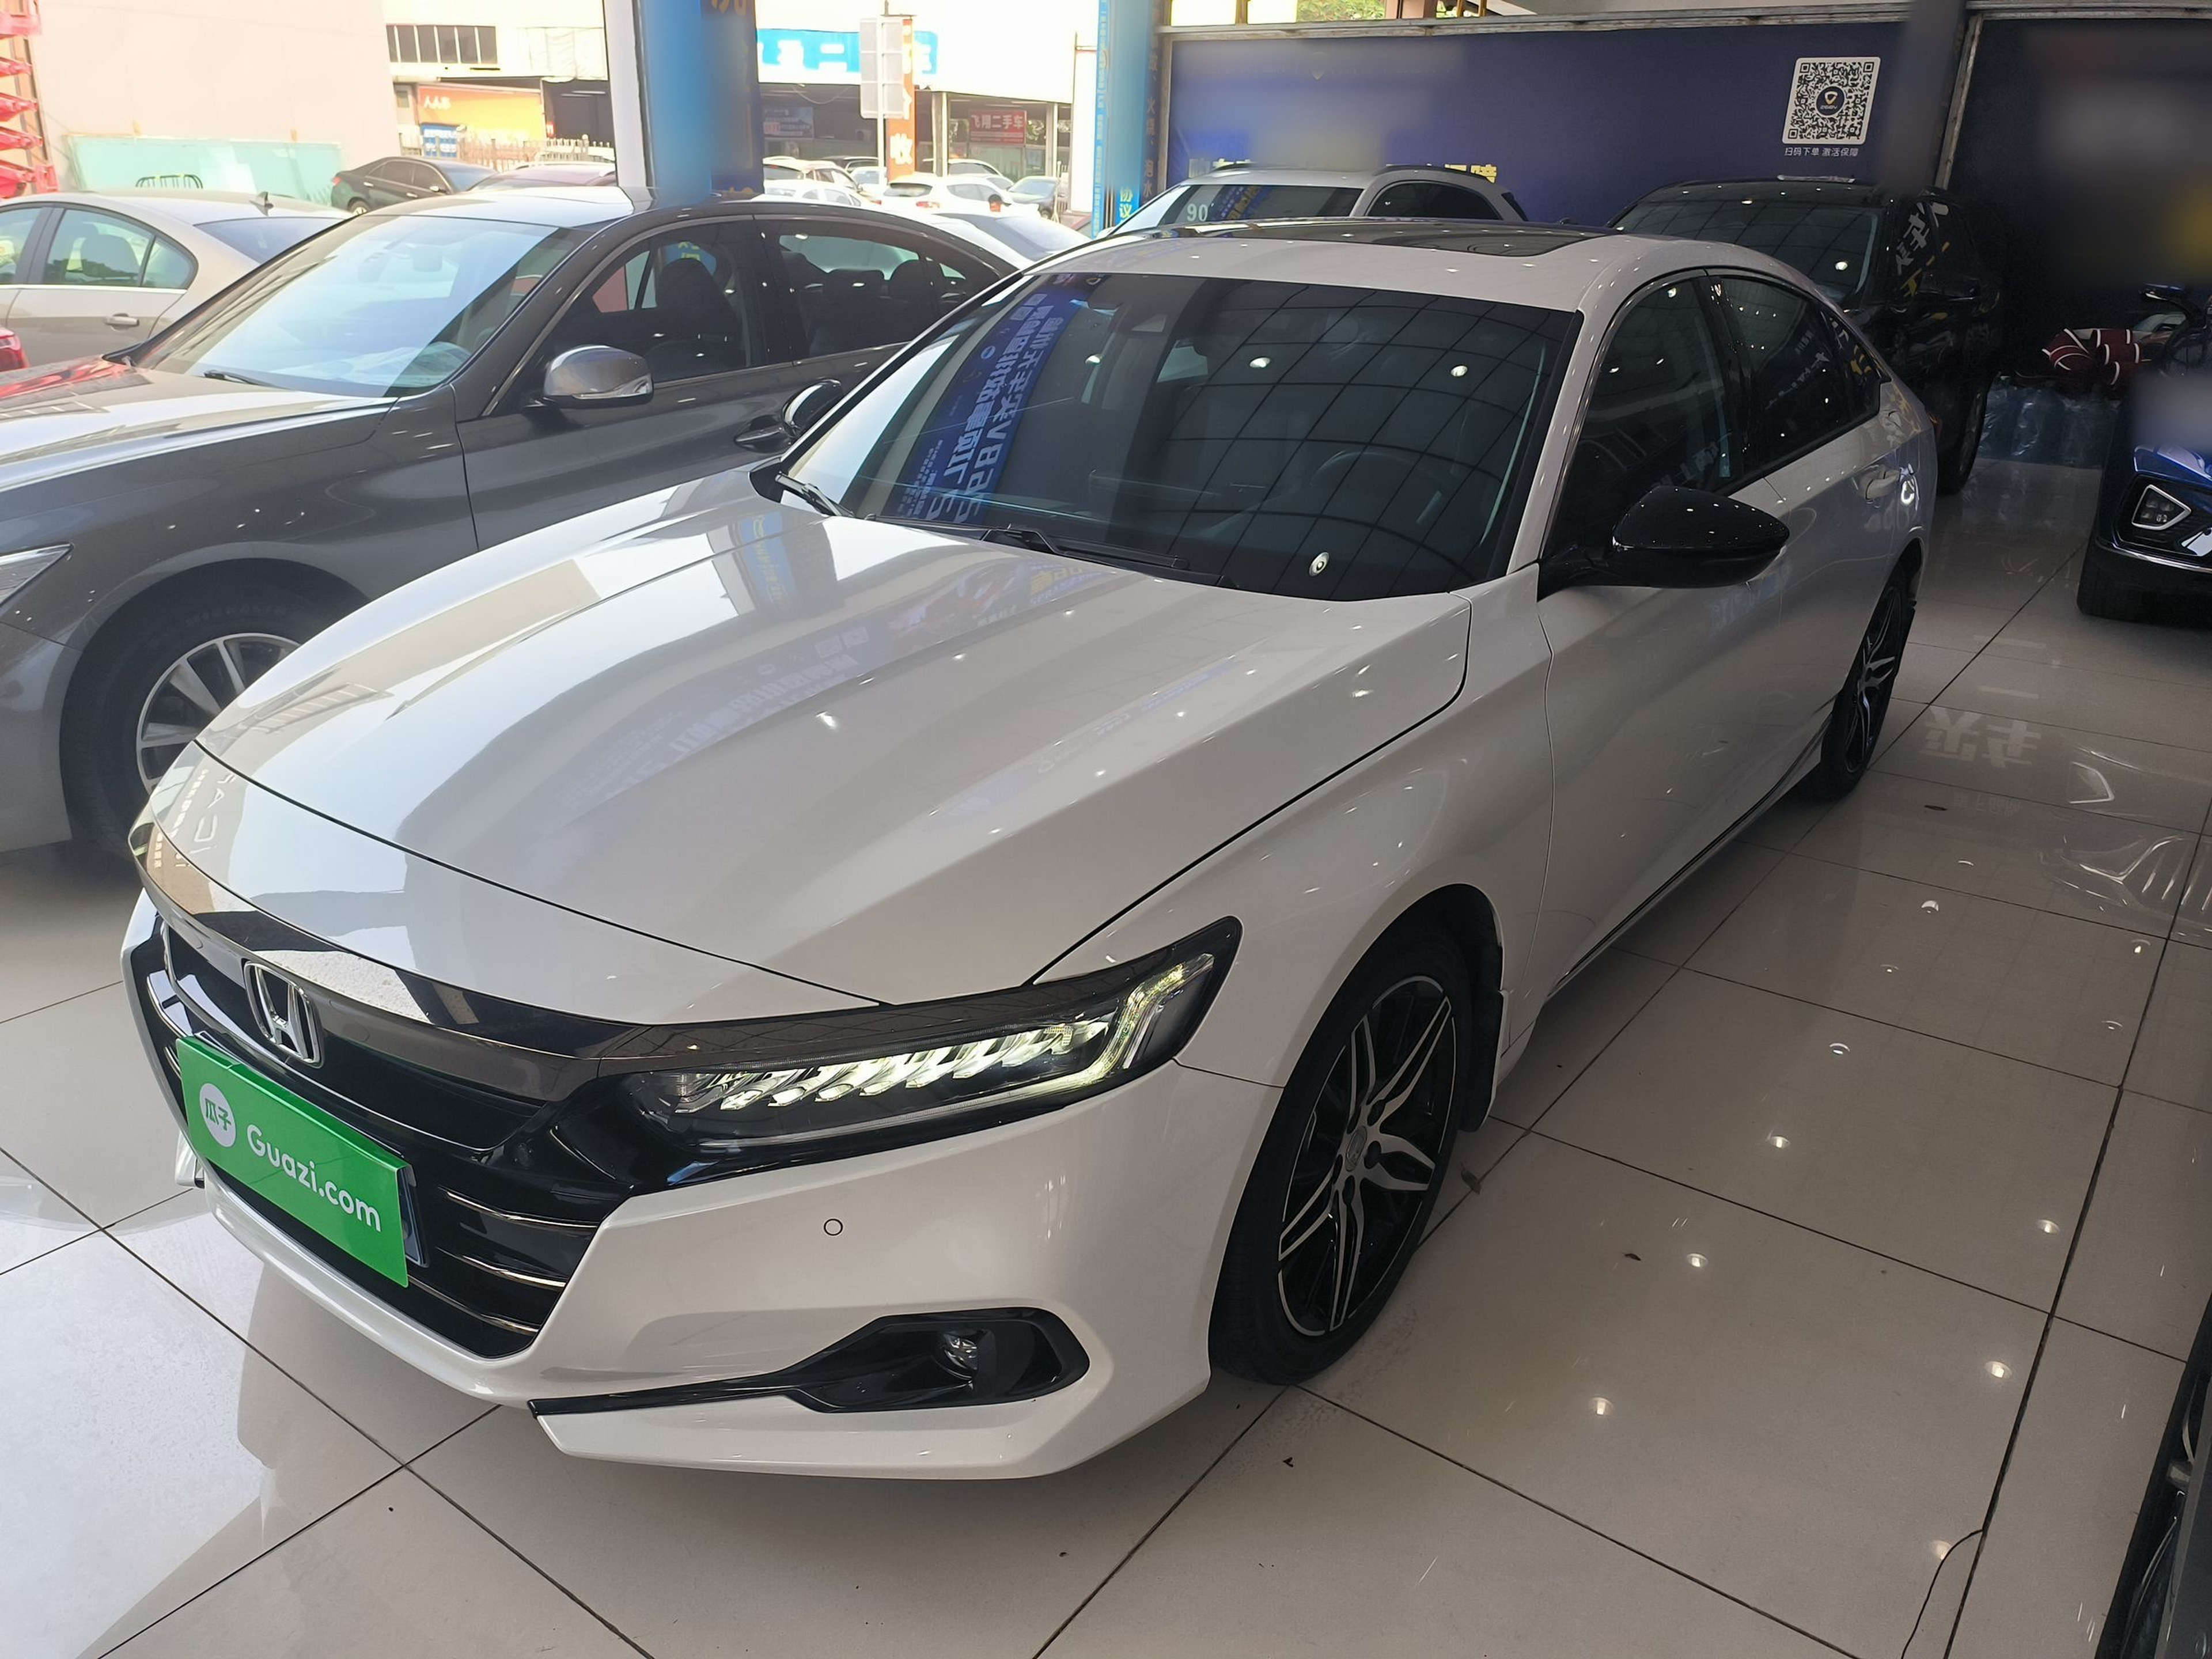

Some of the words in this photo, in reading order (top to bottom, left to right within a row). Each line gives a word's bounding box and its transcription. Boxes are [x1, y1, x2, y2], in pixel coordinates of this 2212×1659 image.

[1784, 146, 1820, 157] 扫码下单
[1821, 147, 1859, 157] 激活保障
[204, 1098, 232, 1131] 瓜子
[247, 1124, 381, 1232] Guazi.com
